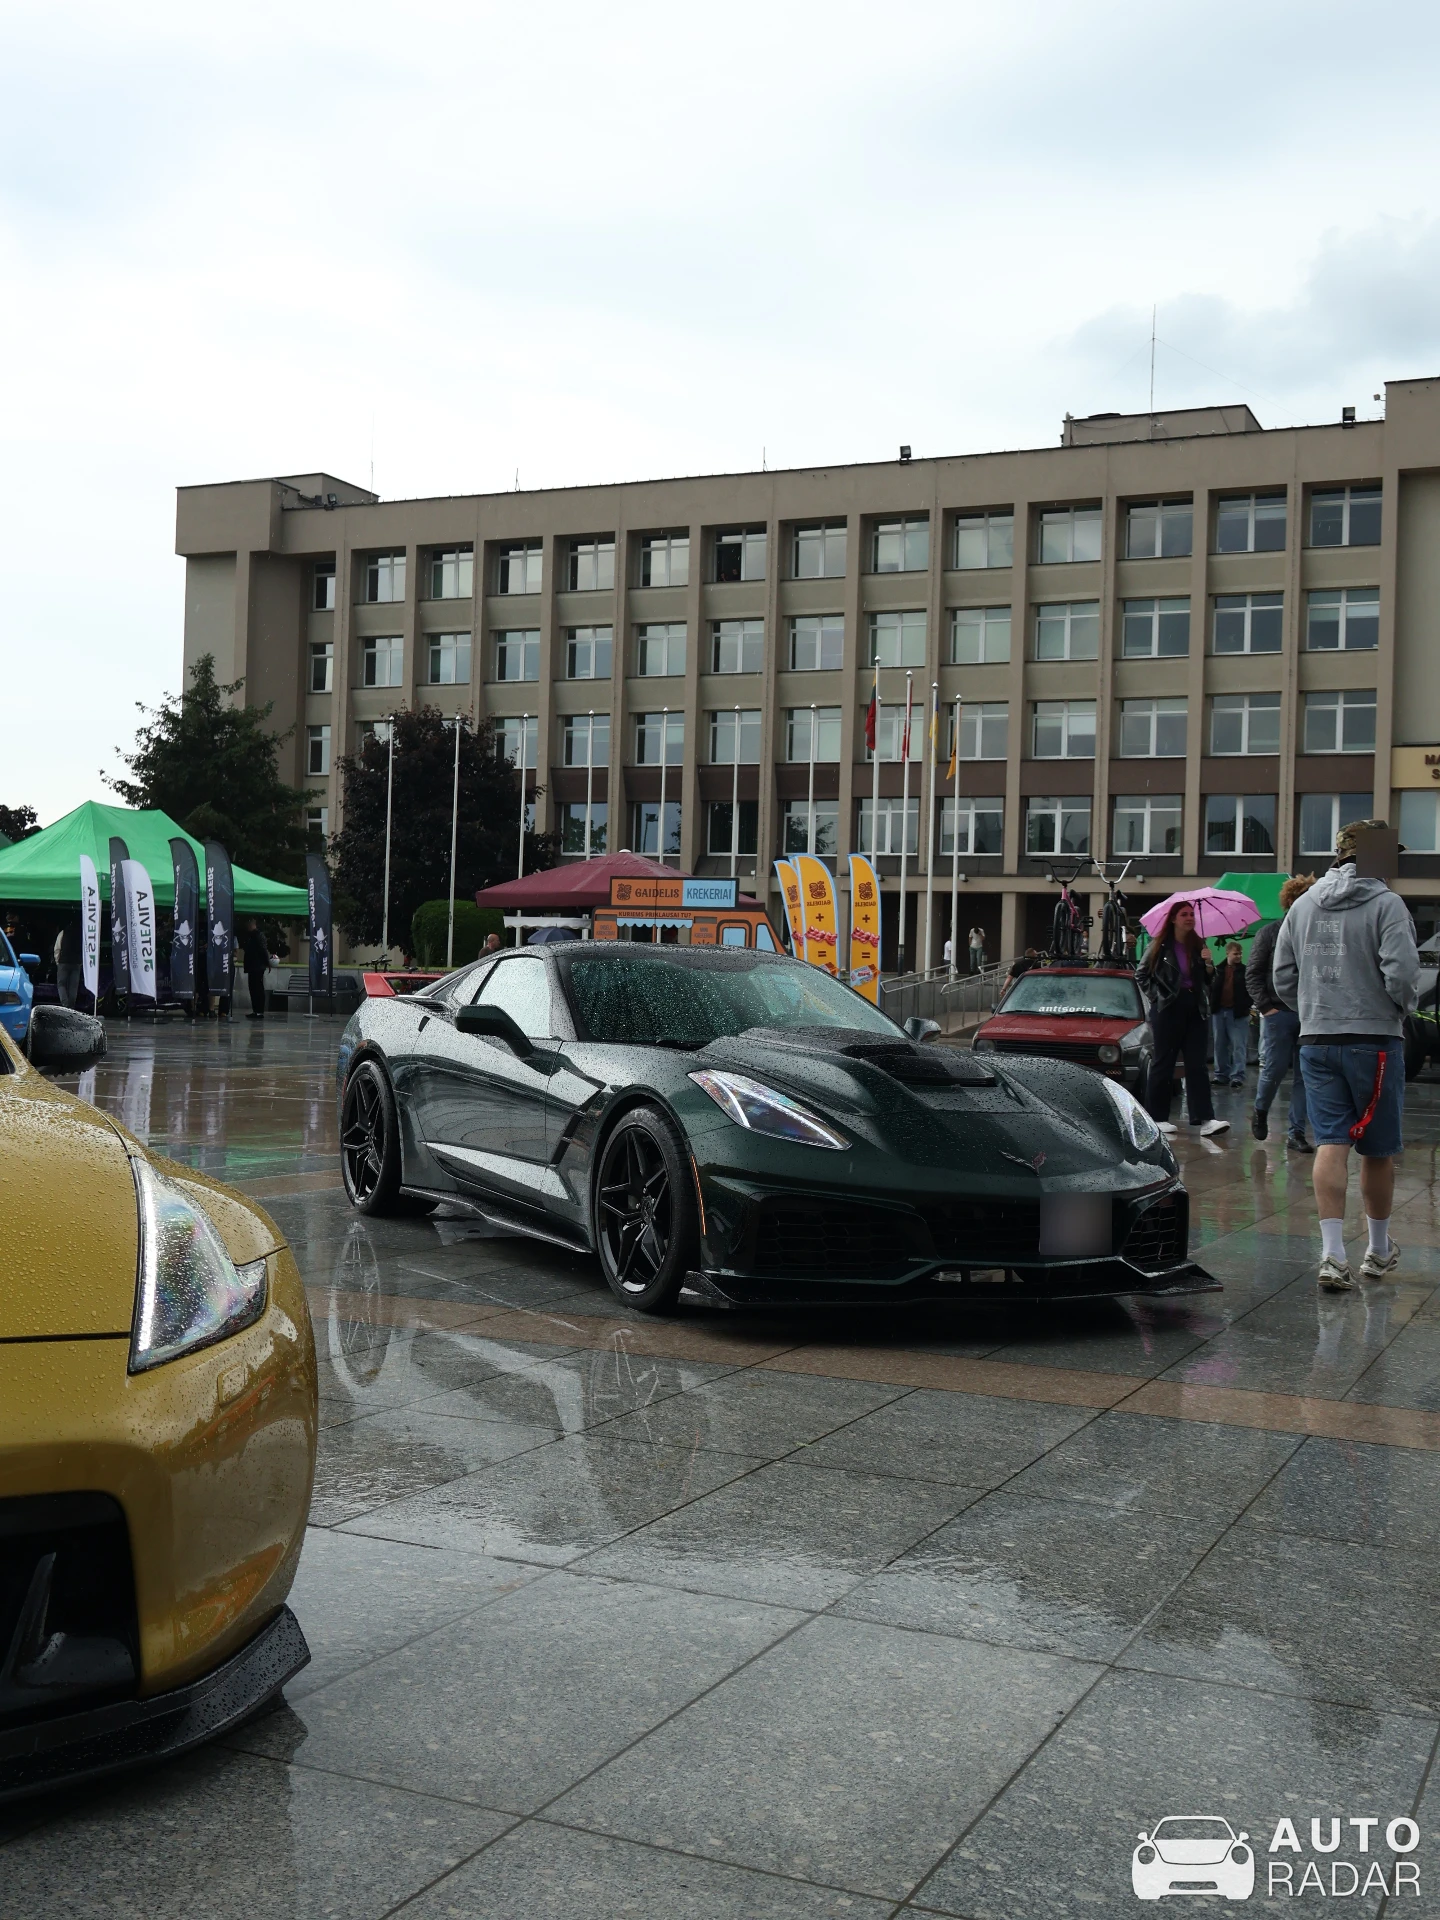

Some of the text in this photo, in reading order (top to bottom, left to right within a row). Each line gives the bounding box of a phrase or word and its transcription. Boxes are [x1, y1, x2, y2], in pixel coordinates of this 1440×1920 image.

[635, 888, 732, 900] GAIDELIS KREKERIAI
[1315, 920, 1340, 933] THE
[1038, 1005, 1097, 1013] antisocial
